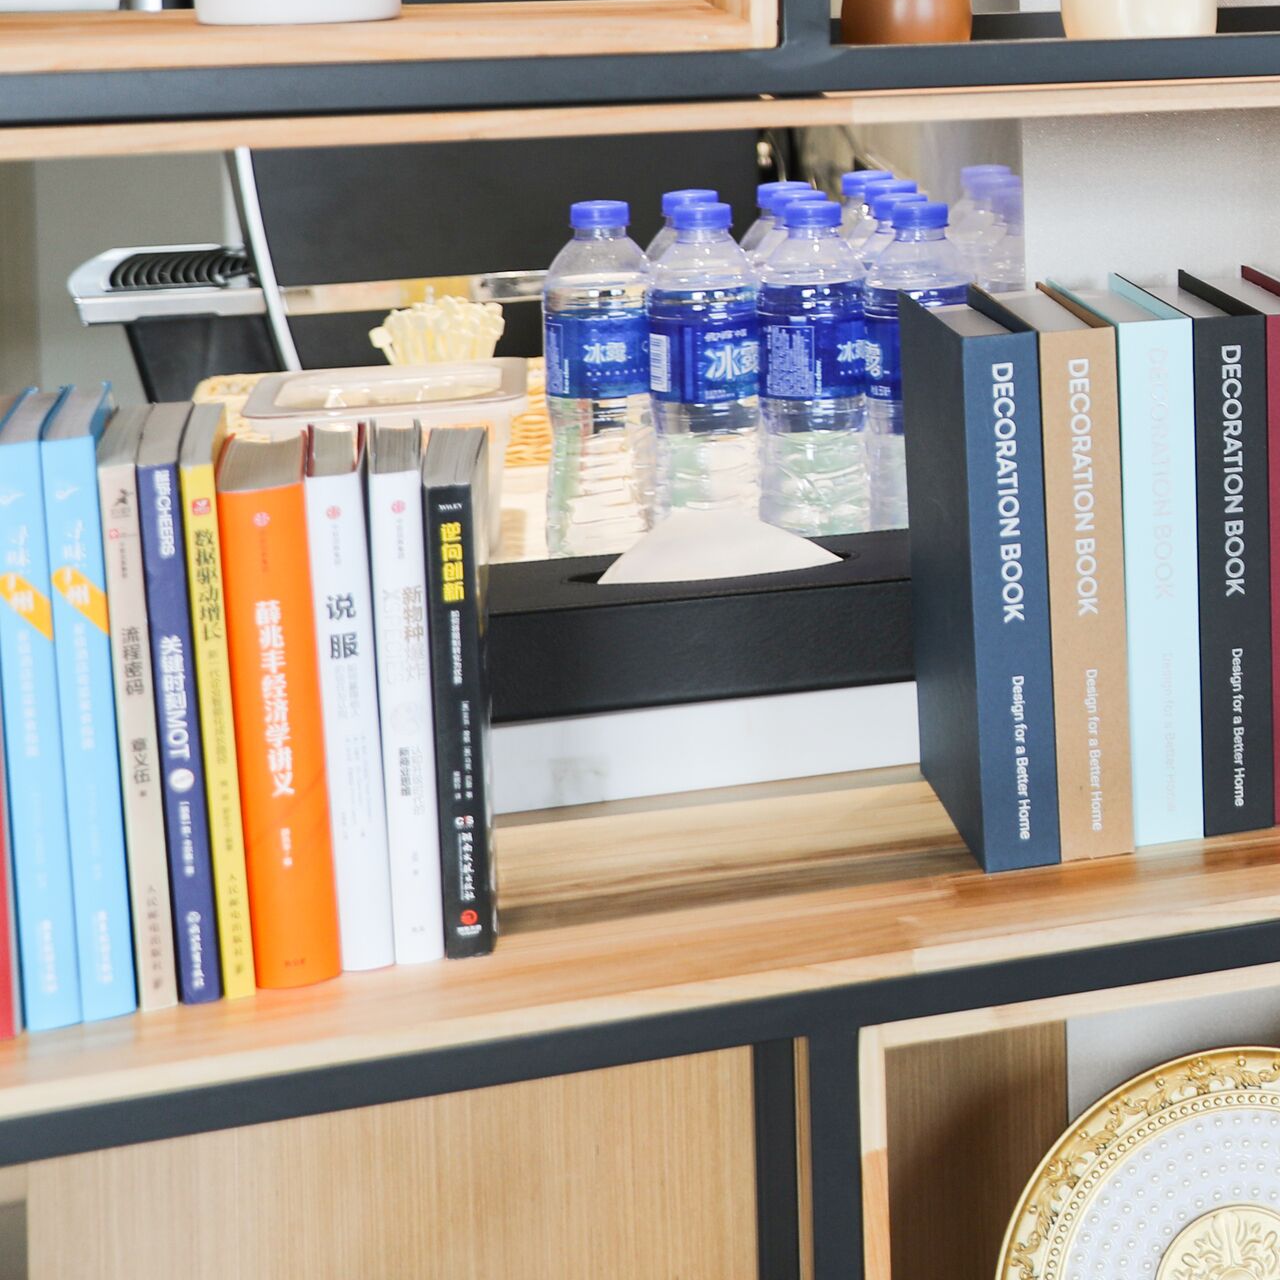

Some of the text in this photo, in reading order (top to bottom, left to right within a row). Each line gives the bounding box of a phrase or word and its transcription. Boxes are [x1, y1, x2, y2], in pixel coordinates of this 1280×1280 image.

[440, 521, 465, 603] 逆向创新
[991, 362, 1025, 624] DECORATION BOOK
[1067, 358, 1098, 617] DECORATION BOOK
[1146, 347, 1175, 600] DECORATION BOOK
[1221, 344, 1246, 597] DECORATION BOOK
[1010, 675, 1031, 840] Design for a Better Home
[1084, 669, 1103, 832] Design for a Better Home
[1229, 648, 1246, 807] Design for a Better Home
